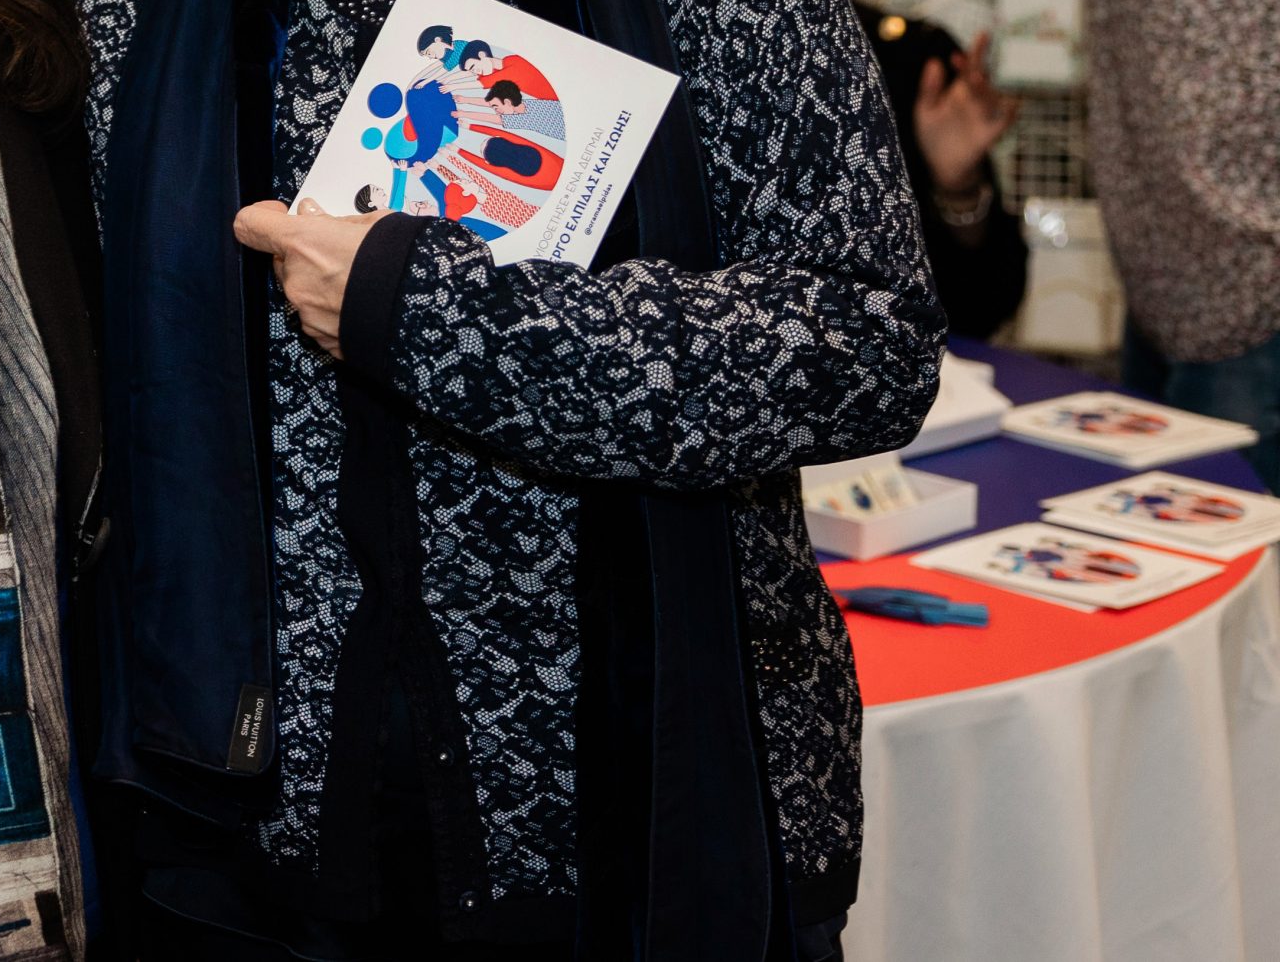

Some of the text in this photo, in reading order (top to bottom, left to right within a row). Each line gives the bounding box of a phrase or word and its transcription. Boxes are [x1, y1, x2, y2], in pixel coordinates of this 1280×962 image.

[566, 175, 599, 231] ΕΛΠΙΔΑΣ
[593, 151, 611, 174] ΚΑΙ
[605, 110, 632, 150] ΖΩΗΣ!
[566, 171, 583, 193] ΕΝΑ
[585, 183, 613, 236] @oramaelpidas
[241, 713, 251, 736] PARIS
[247, 698, 264, 758] LOUIS VUITTON
